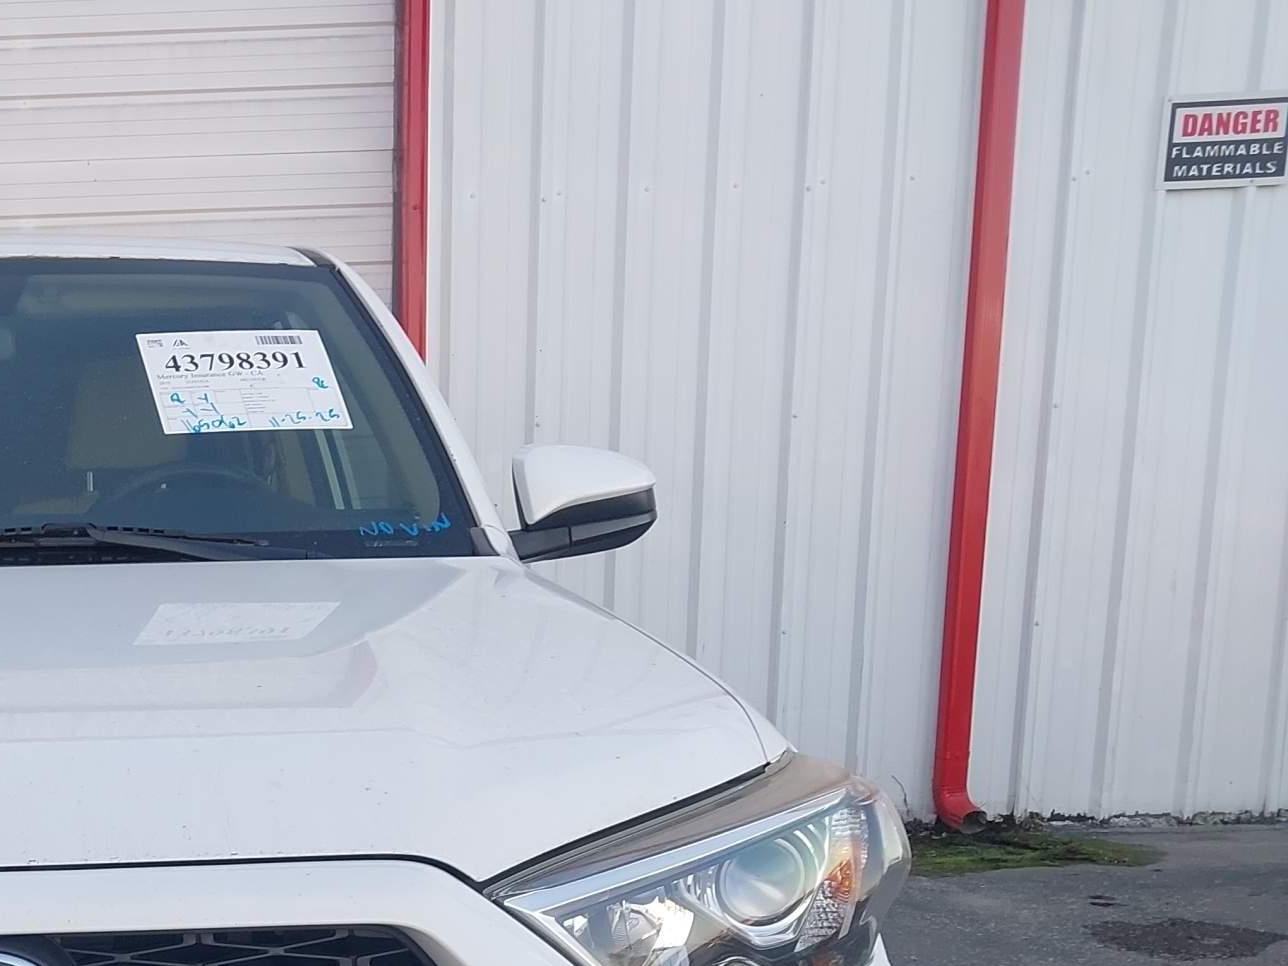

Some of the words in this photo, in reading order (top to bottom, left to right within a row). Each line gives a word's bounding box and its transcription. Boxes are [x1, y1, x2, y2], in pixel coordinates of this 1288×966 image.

[1181, 109, 1280, 137] DANGER
[1171, 141, 1285, 159] FLAMMABLE
[1172, 161, 1278, 178] MATERIALS
[165, 351, 307, 372] 43798391
